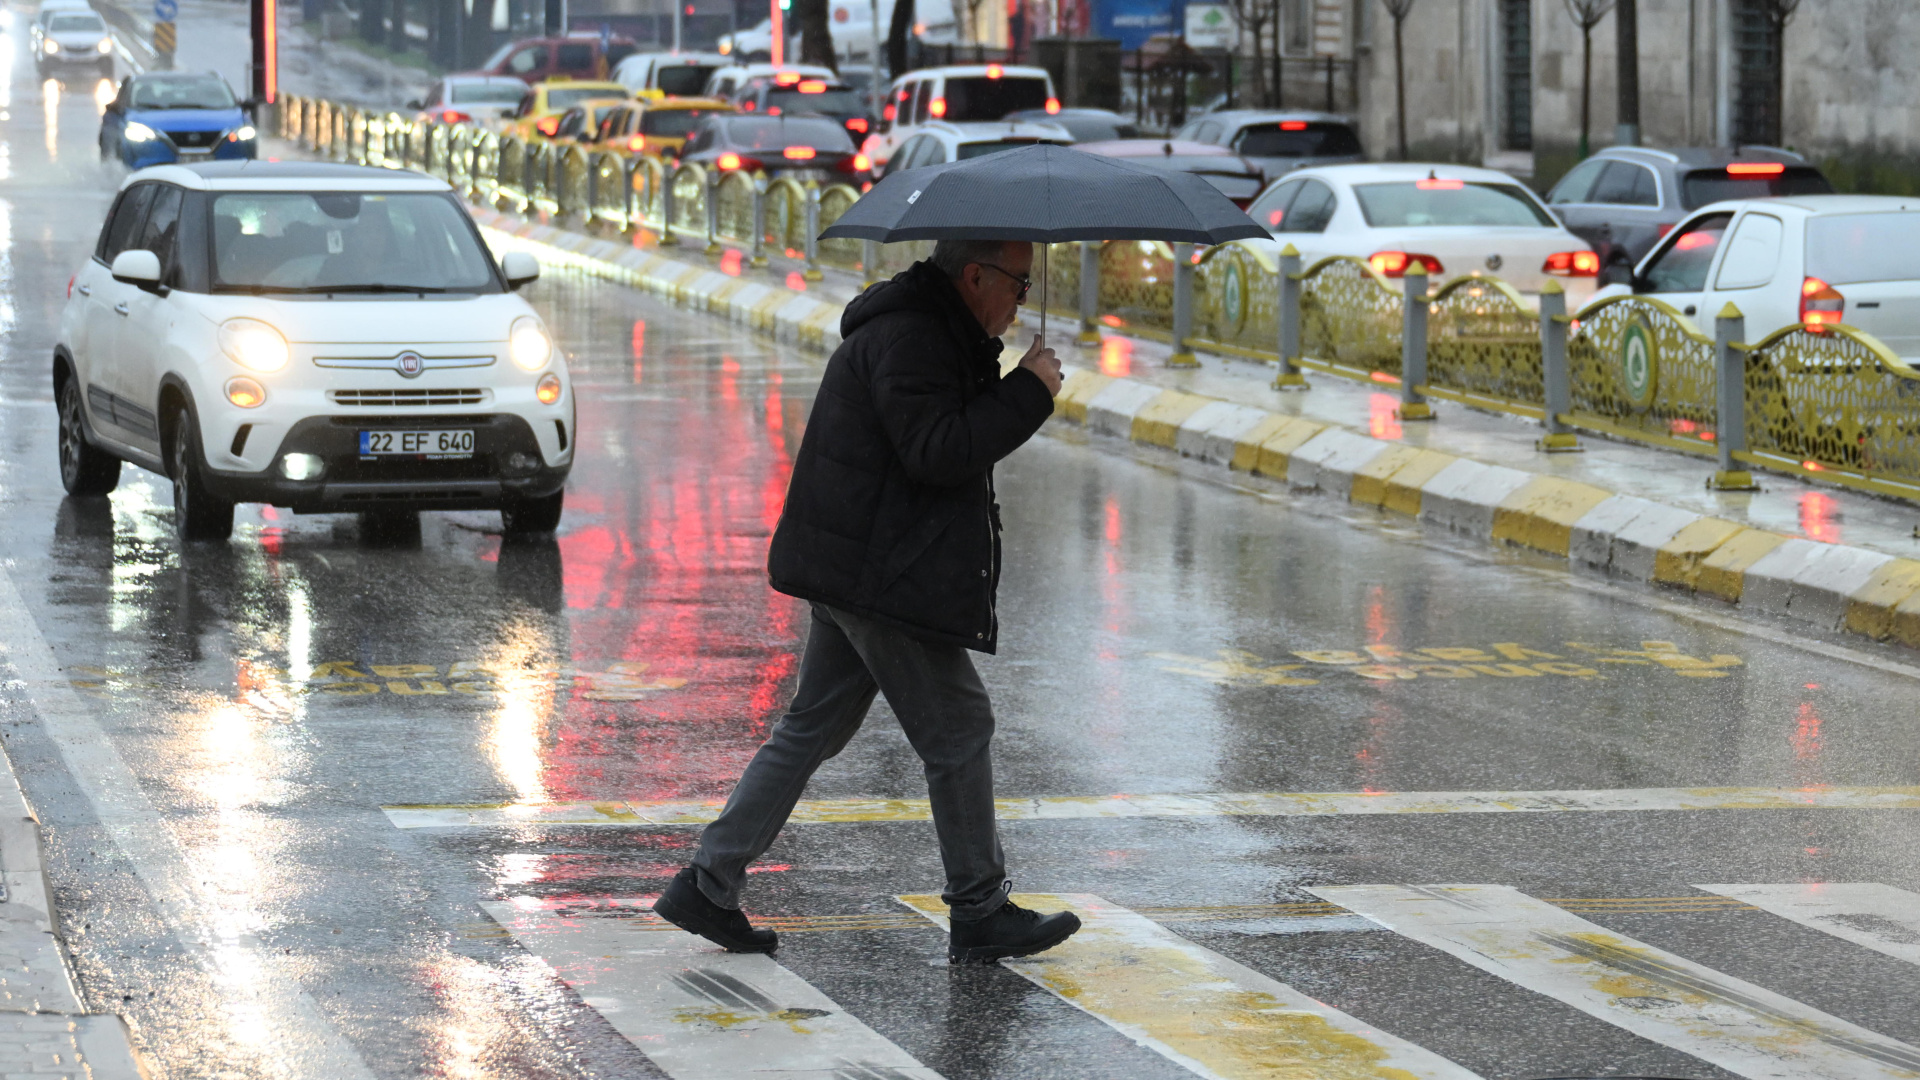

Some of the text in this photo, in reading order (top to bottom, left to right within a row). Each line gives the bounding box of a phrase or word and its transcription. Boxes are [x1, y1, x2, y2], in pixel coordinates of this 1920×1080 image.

[370, 433, 393, 452] 22
[402, 433, 429, 452] EF
[438, 432, 473, 452] 640
